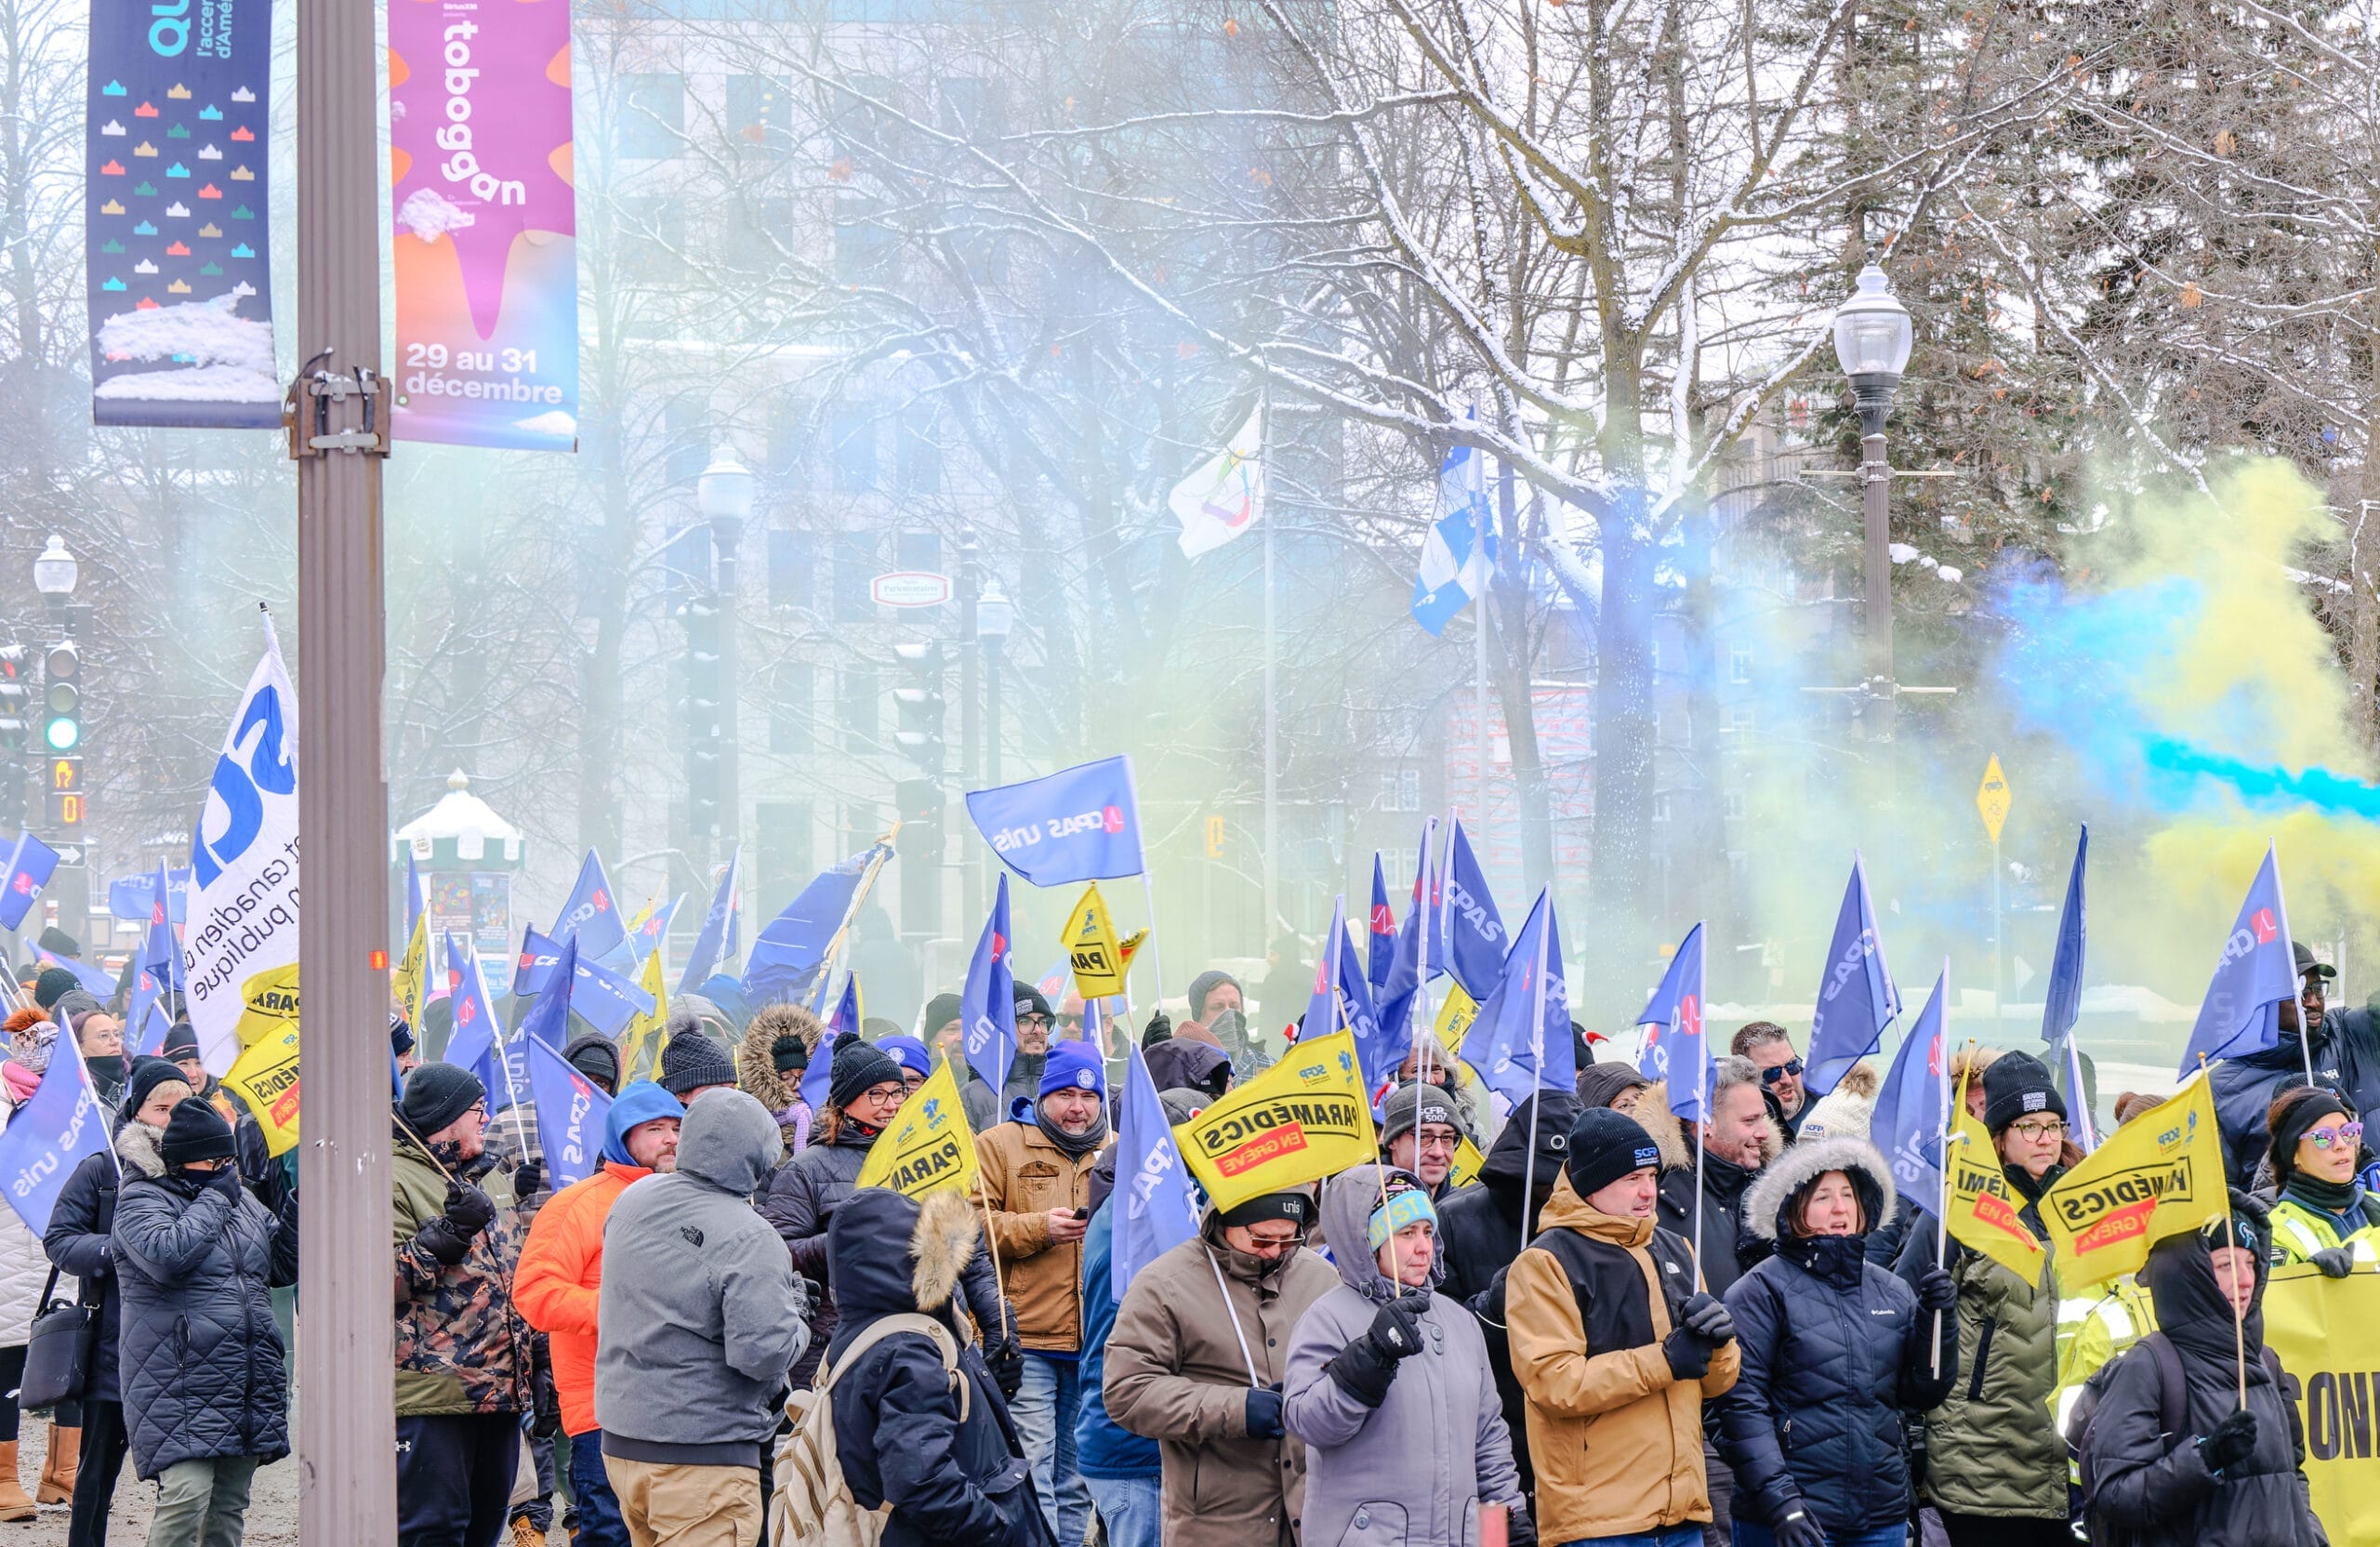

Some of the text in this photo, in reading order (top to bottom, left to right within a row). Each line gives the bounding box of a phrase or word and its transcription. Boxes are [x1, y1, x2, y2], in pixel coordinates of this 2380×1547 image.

[435, 20, 526, 205] toboggan
[406, 343, 536, 373] 29 au 31
[405, 372, 563, 404] décembre
[1447, 879, 1503, 942] CPAS
[1283, 1200, 1301, 1214] unis
[2285, 1370, 2380, 1461] ON
